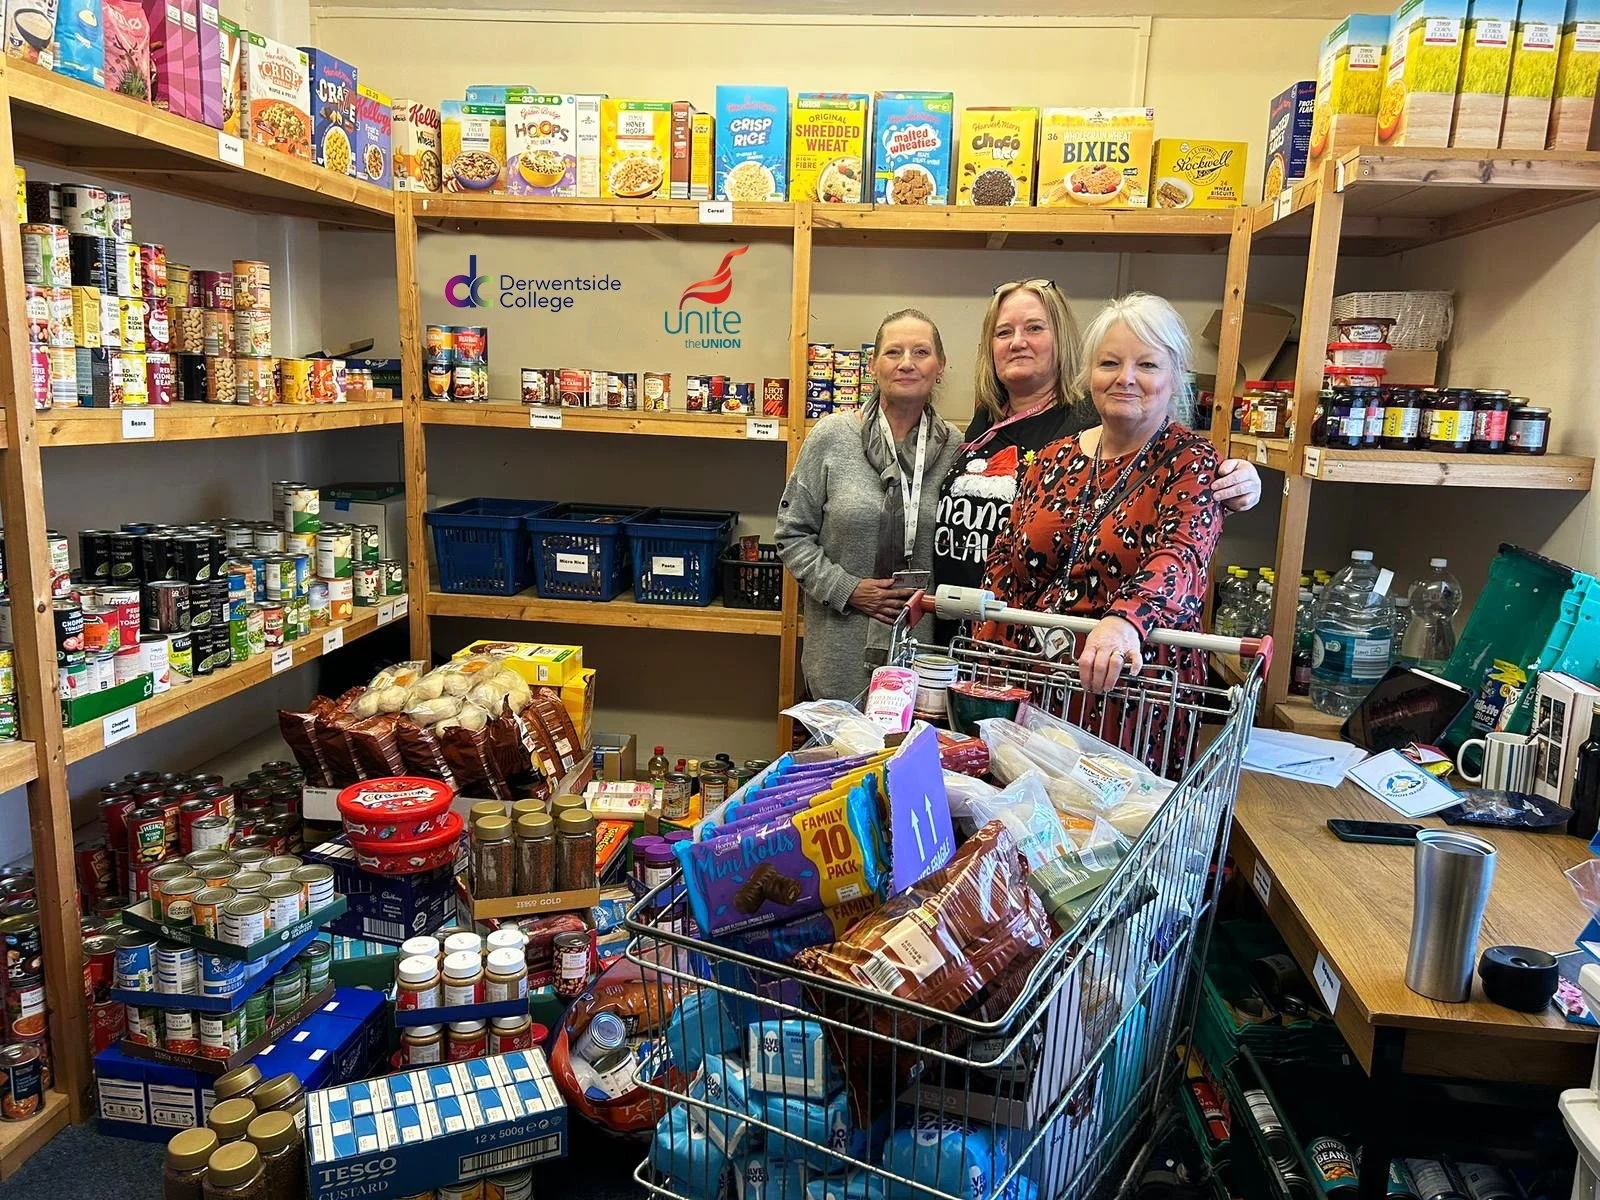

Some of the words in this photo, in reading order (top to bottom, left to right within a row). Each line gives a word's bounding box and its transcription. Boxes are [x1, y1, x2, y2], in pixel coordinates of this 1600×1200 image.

[261, 61, 302, 89] CRISP
[730, 117, 774, 133] CRISP
[808, 113, 847, 124] ORIGINAL
[515, 120, 570, 143] HOOPS
[733, 132, 767, 148] RICE
[795, 124, 860, 138] SHREDDED
[894, 129, 928, 143] malted
[1063, 131, 1105, 141] WHOLEGRAIN
[1105, 131, 1132, 141] WHEAT
[225, 143, 238, 153] Cereal
[806, 138, 849, 153] WHEAT
[889, 137, 937, 155] wheaties
[1062, 141, 1130, 164] BIXIES
[795, 161, 817, 169] FIBRE
[1172, 149, 1234, 173] Stockwell
[935, 495, 1013, 532] nana
[934, 526, 989, 564] CLAU
[1521, 687, 1536, 709] IFCO
[110, 724, 131, 736] Tomatoes
[111, 718, 129, 728] Chopped
[142, 823, 164, 832] HEINZ
[801, 808, 843, 831] FAMILY
[811, 824, 853, 864] 10
[695, 846, 743, 881] Mini
[740, 832, 795, 867] Rolls
[930, 836, 951, 872] FRAGILE
[825, 859, 859, 880] PACK
[539, 897, 562, 906] GOLD
[832, 898, 875, 920] FAMILY
[218, 980, 244, 993] PUDDING
[475, 1135, 488, 1145] 12
[489, 1133, 497, 1141] x
[498, 1126, 524, 1139] 500g
[1316, 1141, 1345, 1153] HEINZ
[1316, 1151, 1351, 1164] BEANZ
[318, 1156, 397, 1184] TESCO
[318, 1181, 389, 1200] CUSTARD
